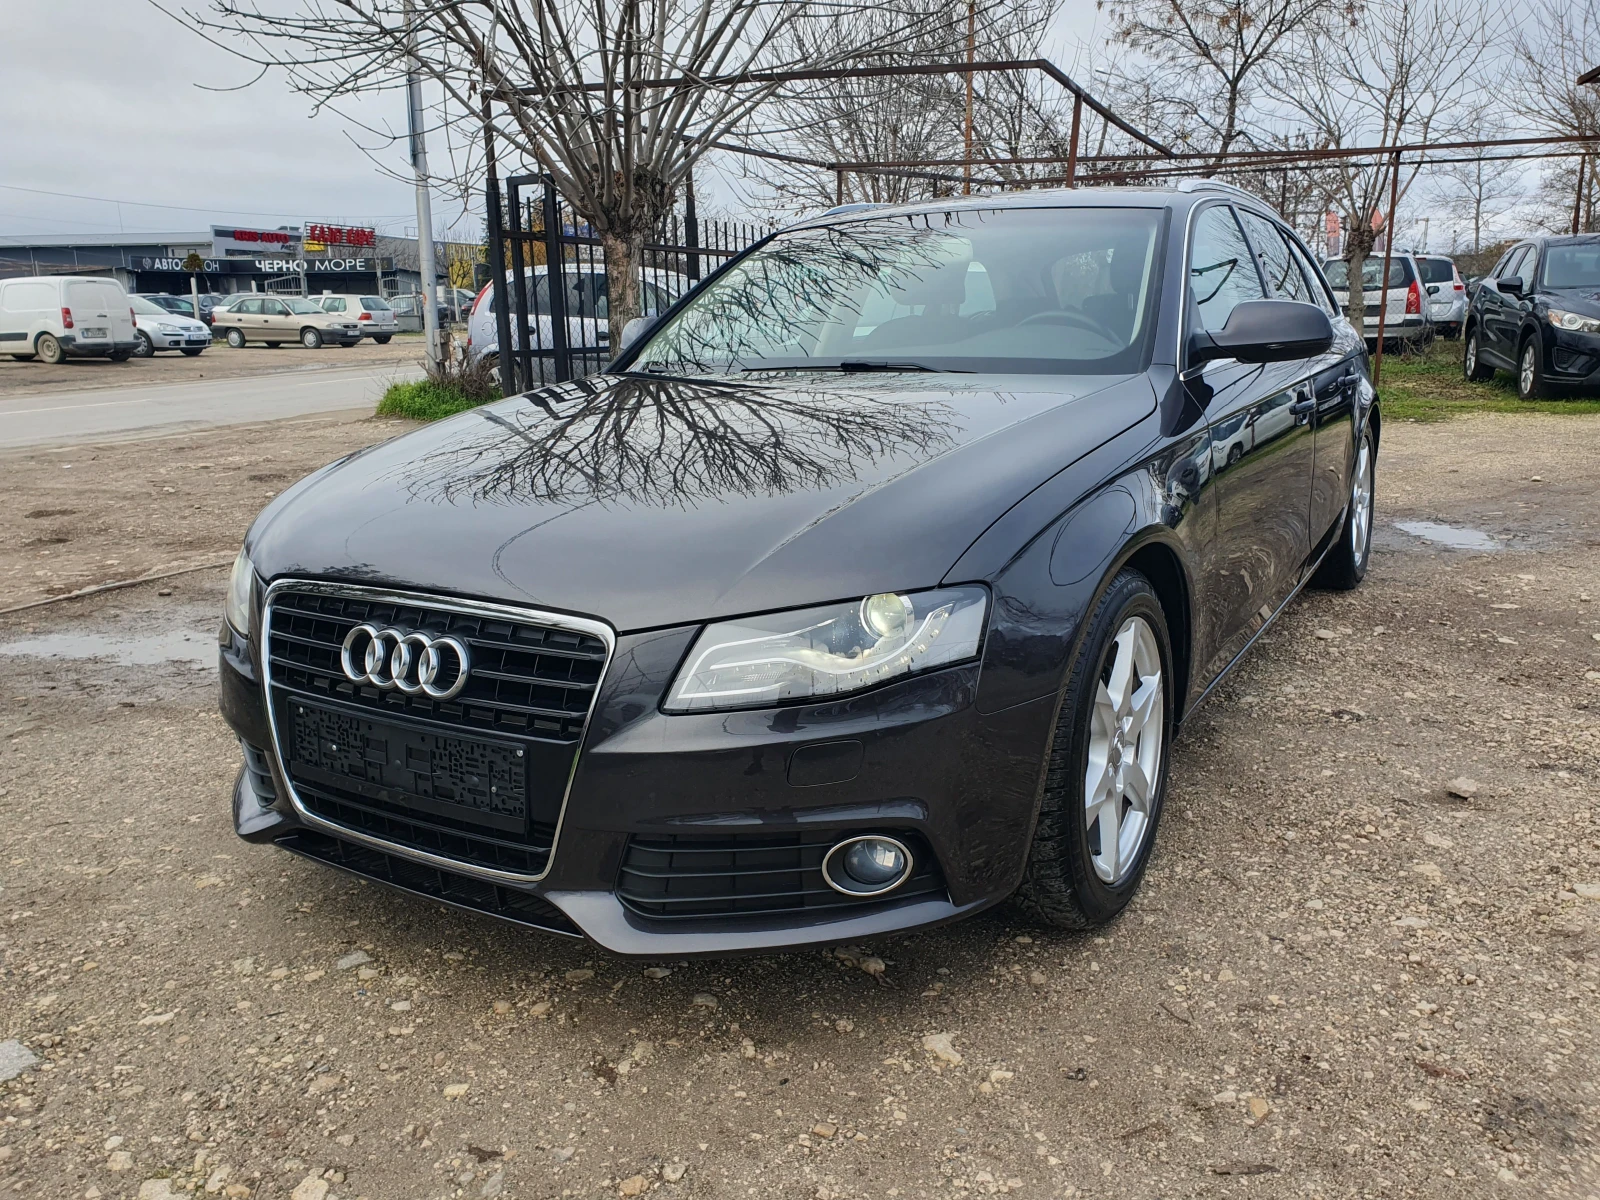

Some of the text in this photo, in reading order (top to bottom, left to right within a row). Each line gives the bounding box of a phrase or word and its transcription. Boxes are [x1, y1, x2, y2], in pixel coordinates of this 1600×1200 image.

[234, 230, 290, 244] KRIS AUTO
[154, 258, 219, 271] АВТОСОН
[255, 260, 307, 271] ЧЕРНО
[315, 259, 365, 270] МОРЕ
